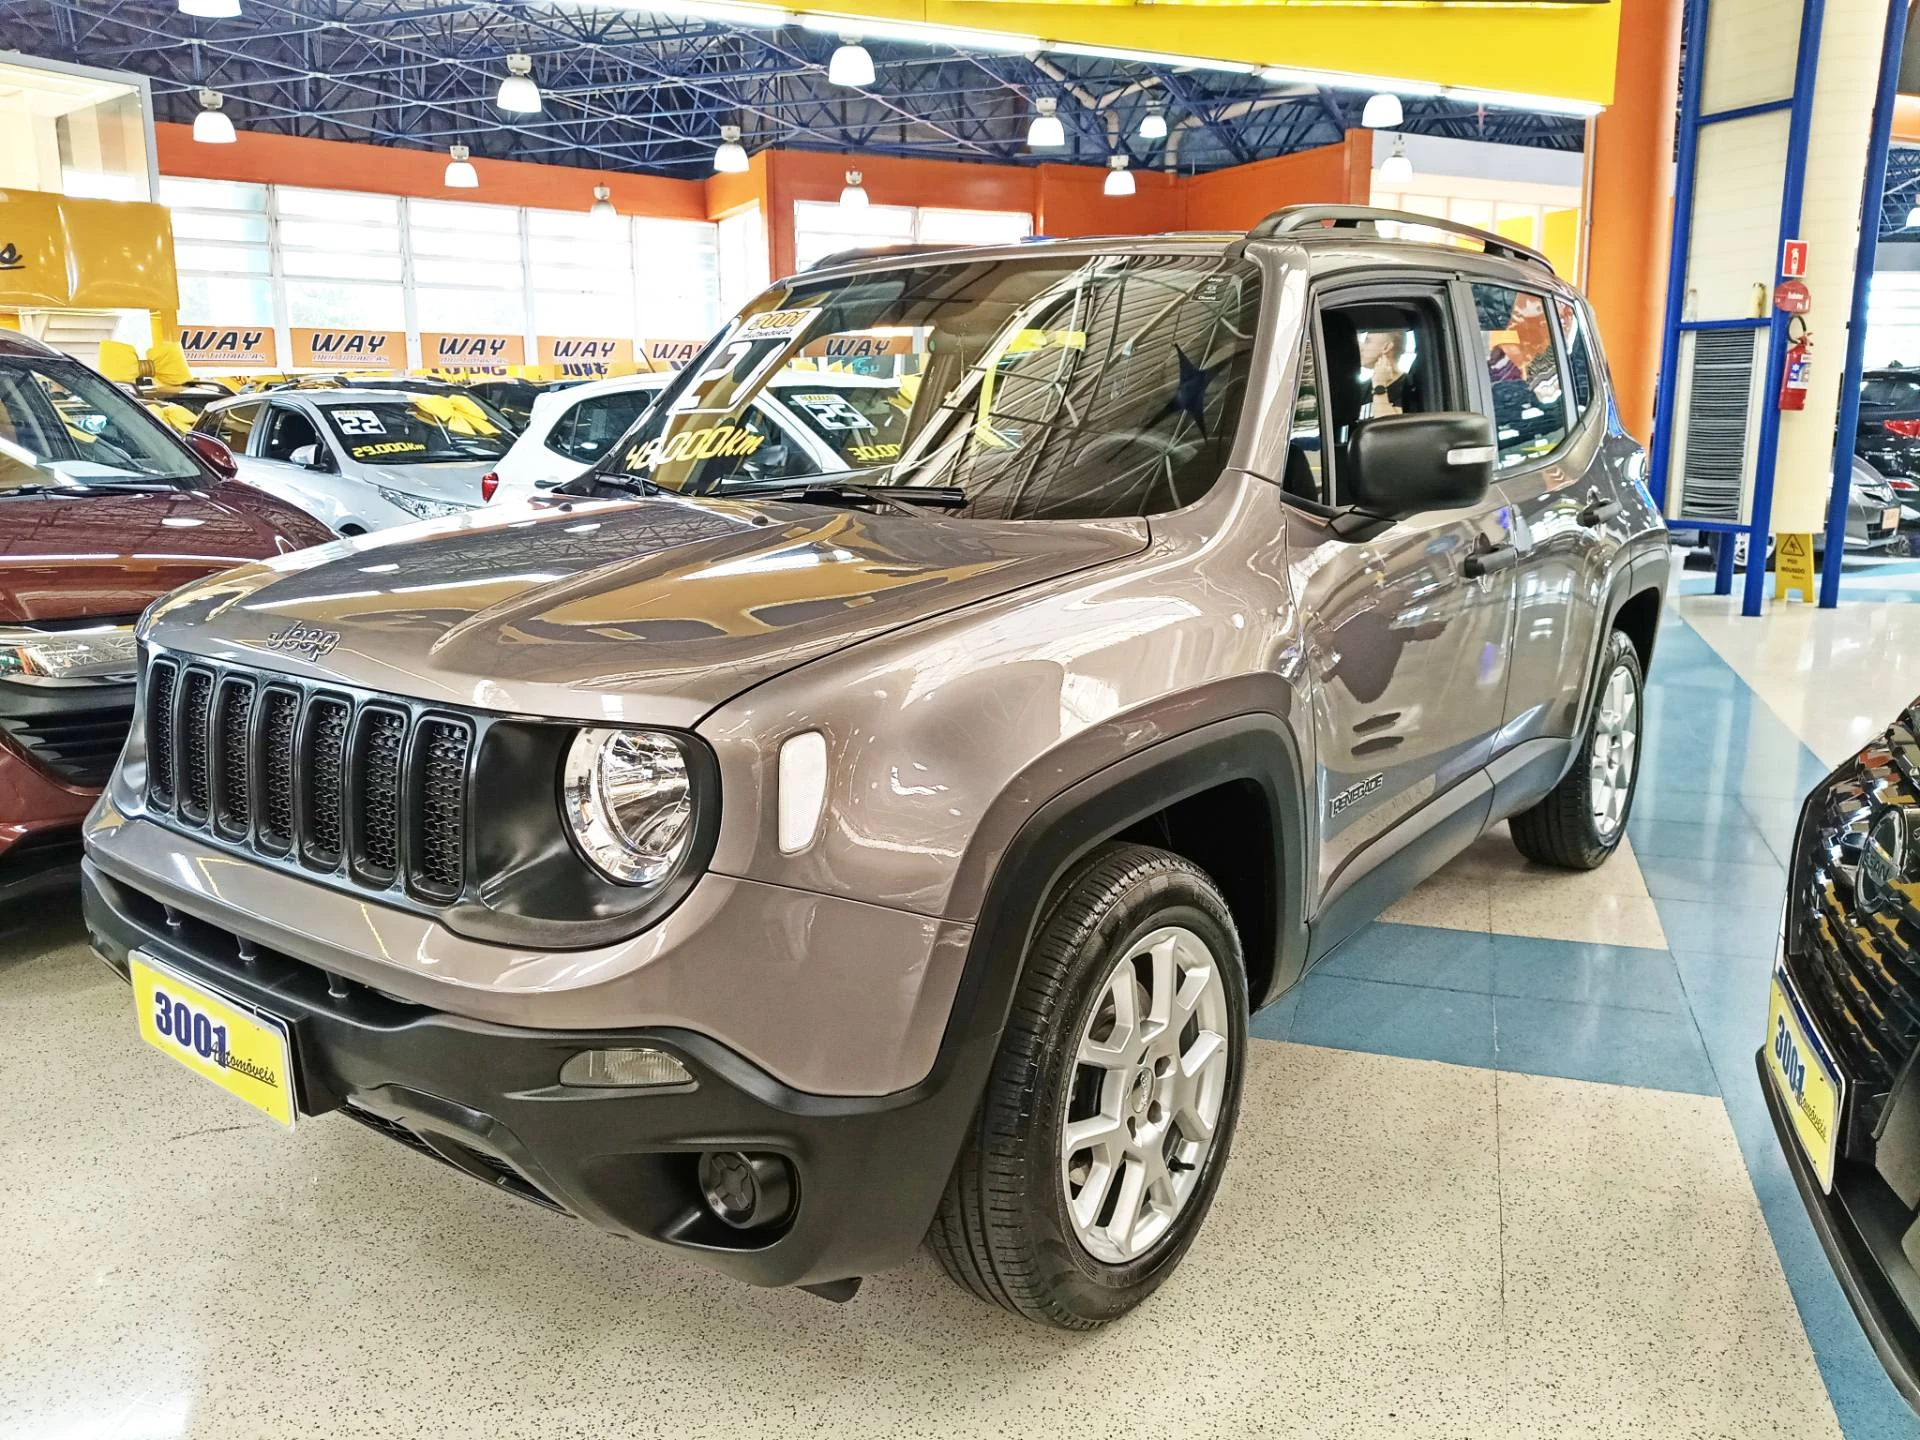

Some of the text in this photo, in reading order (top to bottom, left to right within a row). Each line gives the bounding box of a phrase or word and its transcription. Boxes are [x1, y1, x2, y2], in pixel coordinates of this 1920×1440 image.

[181, 331, 262, 350] WAY
[312, 334, 385, 352] WAY
[440, 338, 505, 355] WAY
[554, 341, 615, 357] WAY
[827, 339, 890, 356] WAY
[337, 415, 385, 434] 22
[806, 403, 870, 428] 25
[265, 620, 341, 662] Jeep
[1329, 772, 1383, 818] RENEGADE
[155, 991, 227, 1068] 3001
[1775, 1015, 1805, 1098] 3001
